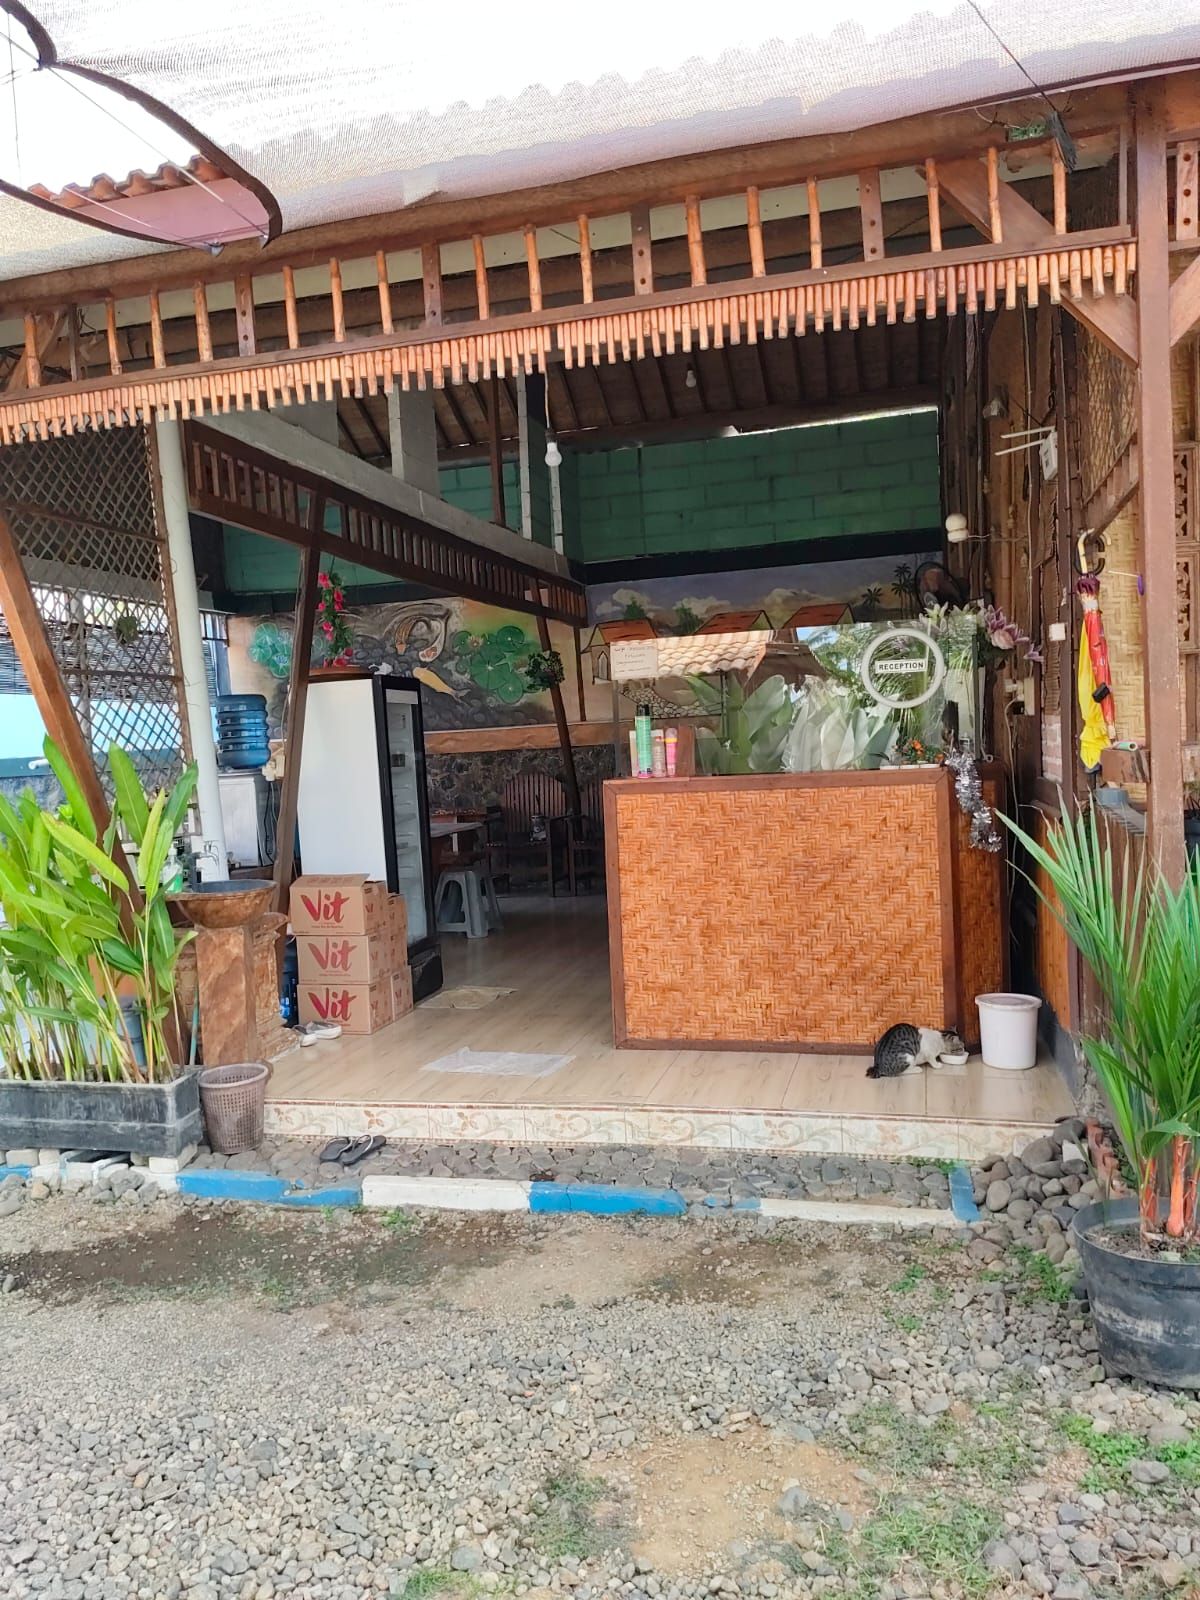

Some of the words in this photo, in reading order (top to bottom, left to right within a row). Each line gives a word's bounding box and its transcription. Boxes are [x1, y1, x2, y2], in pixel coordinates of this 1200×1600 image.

[878, 662, 924, 671] RECEPTION
[300, 889, 350, 923] Vit
[307, 938, 357, 971] Vit
[308, 987, 357, 1021] Vit
